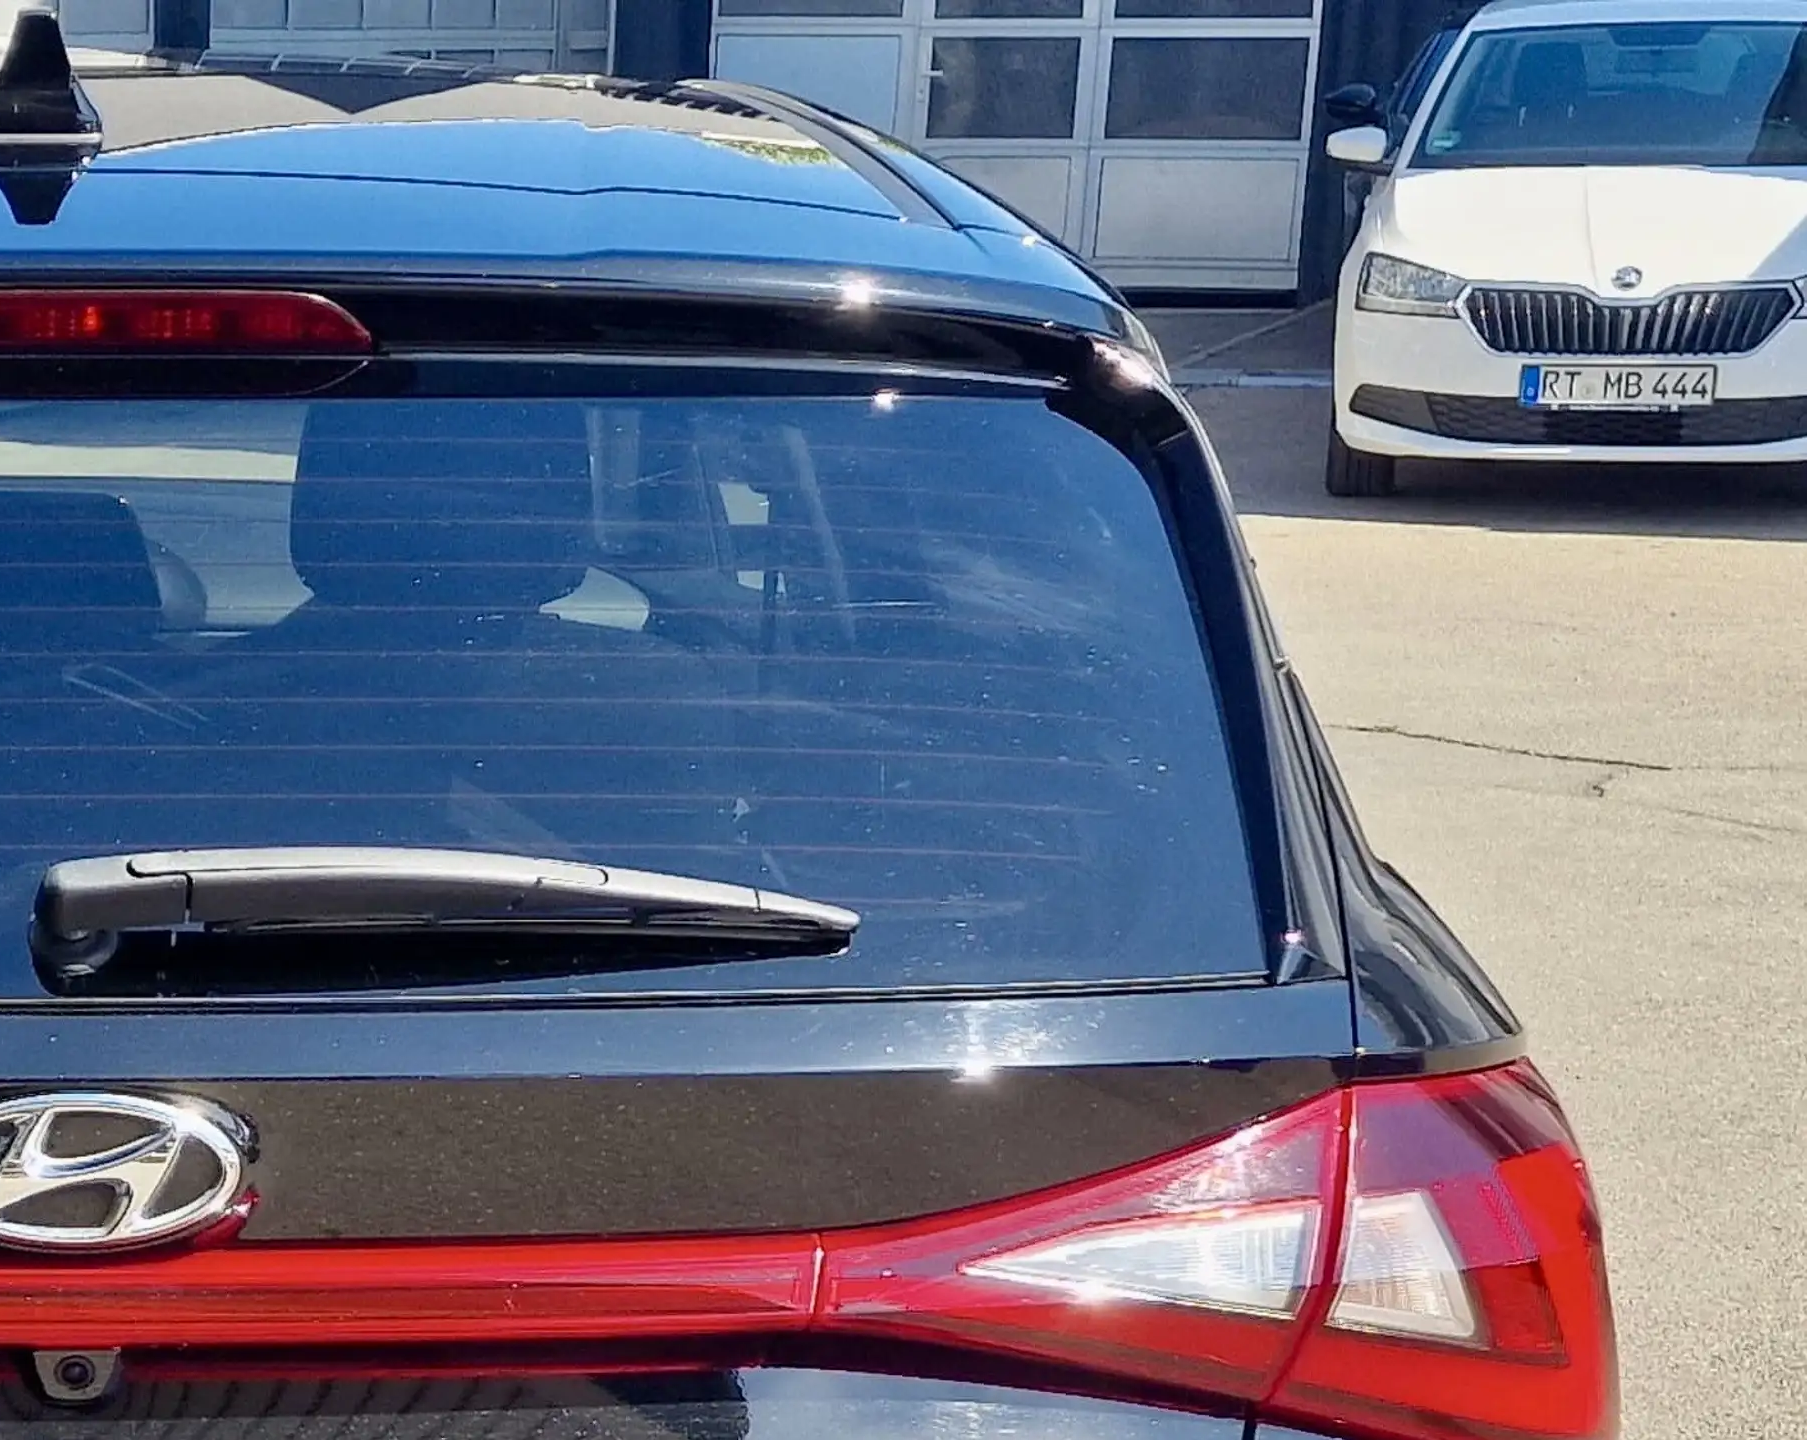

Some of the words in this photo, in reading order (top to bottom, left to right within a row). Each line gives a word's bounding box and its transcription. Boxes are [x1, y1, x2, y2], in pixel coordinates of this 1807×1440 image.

[1542, 370, 1581, 399] RT
[1603, 370, 1643, 399] MB
[1652, 371, 1708, 399] 444
